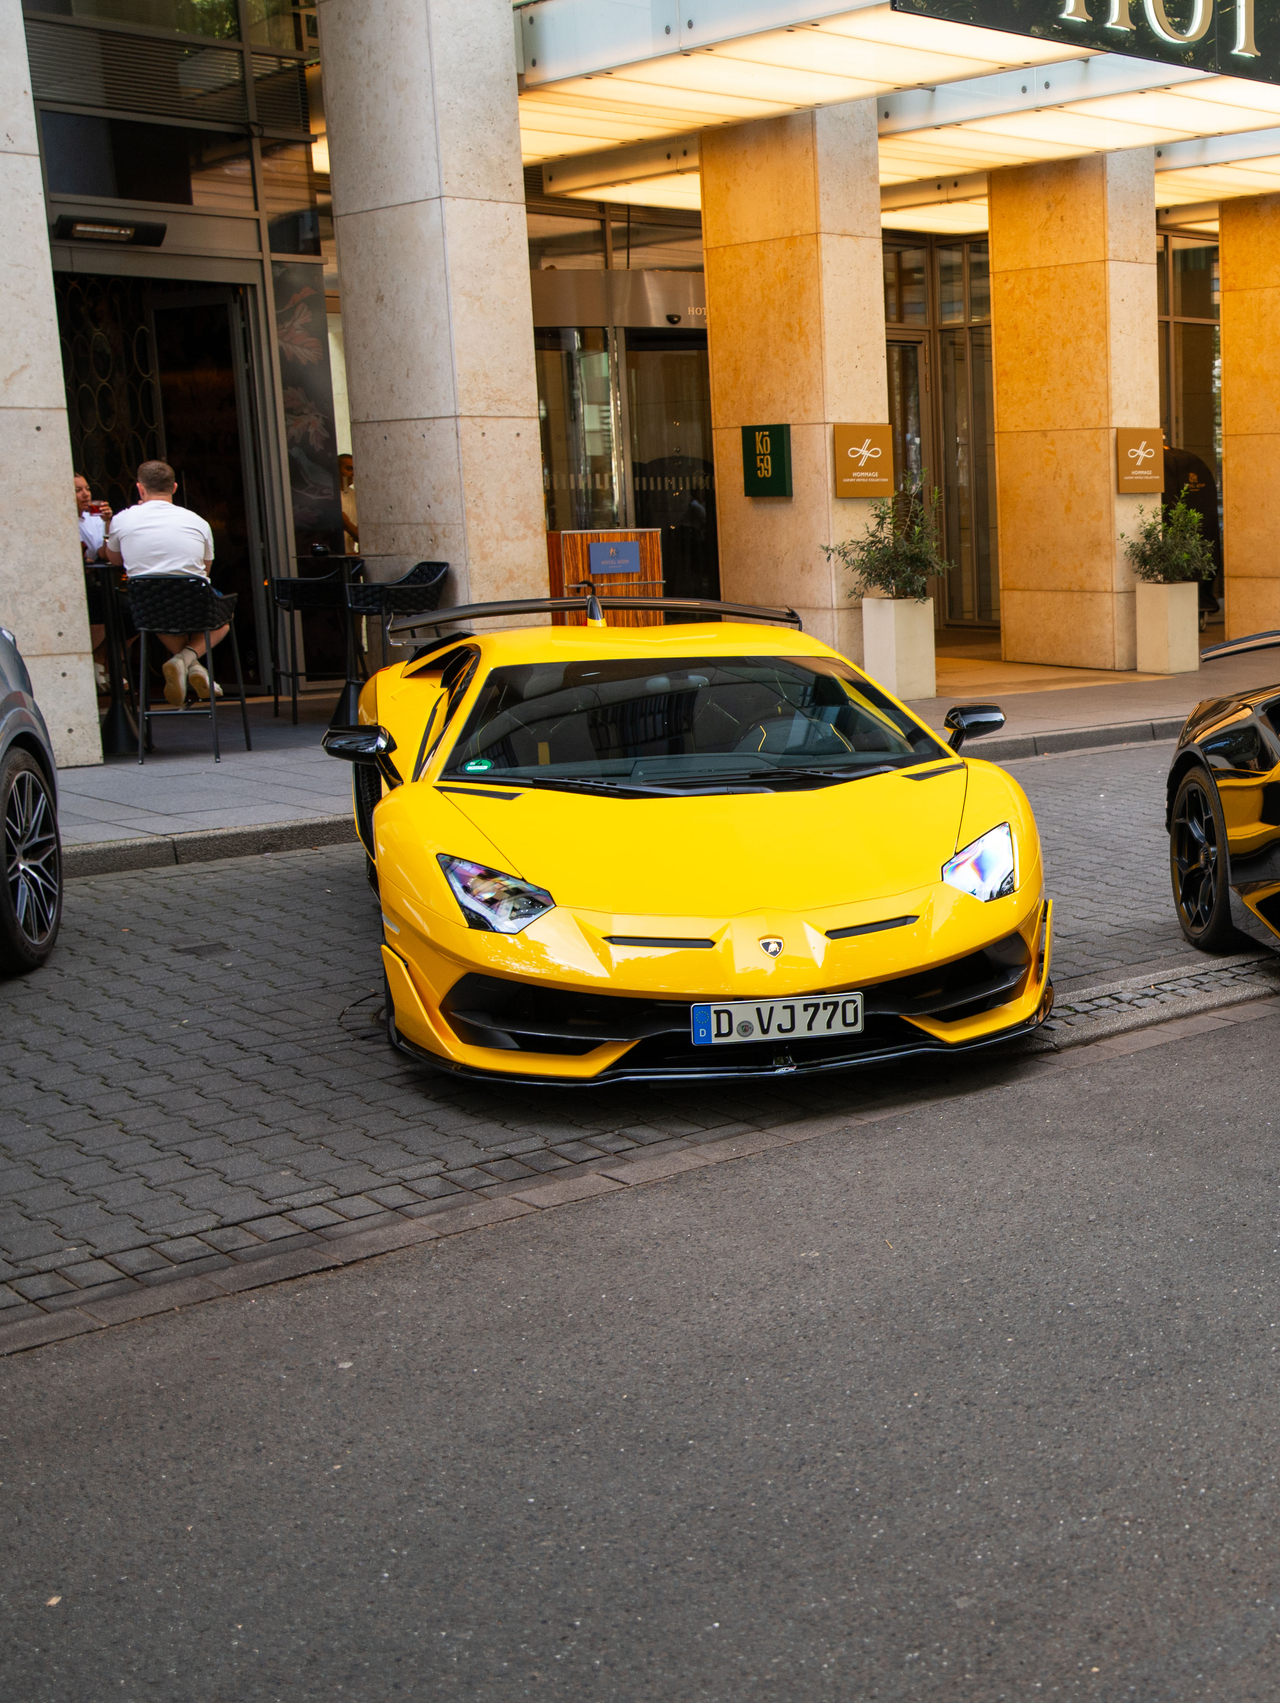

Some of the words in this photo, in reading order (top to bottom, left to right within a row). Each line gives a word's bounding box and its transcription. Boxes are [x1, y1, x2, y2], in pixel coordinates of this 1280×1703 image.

[756, 455, 772, 478] 59
[699, 1028, 707, 1038] D
[713, 1009, 734, 1038] D
